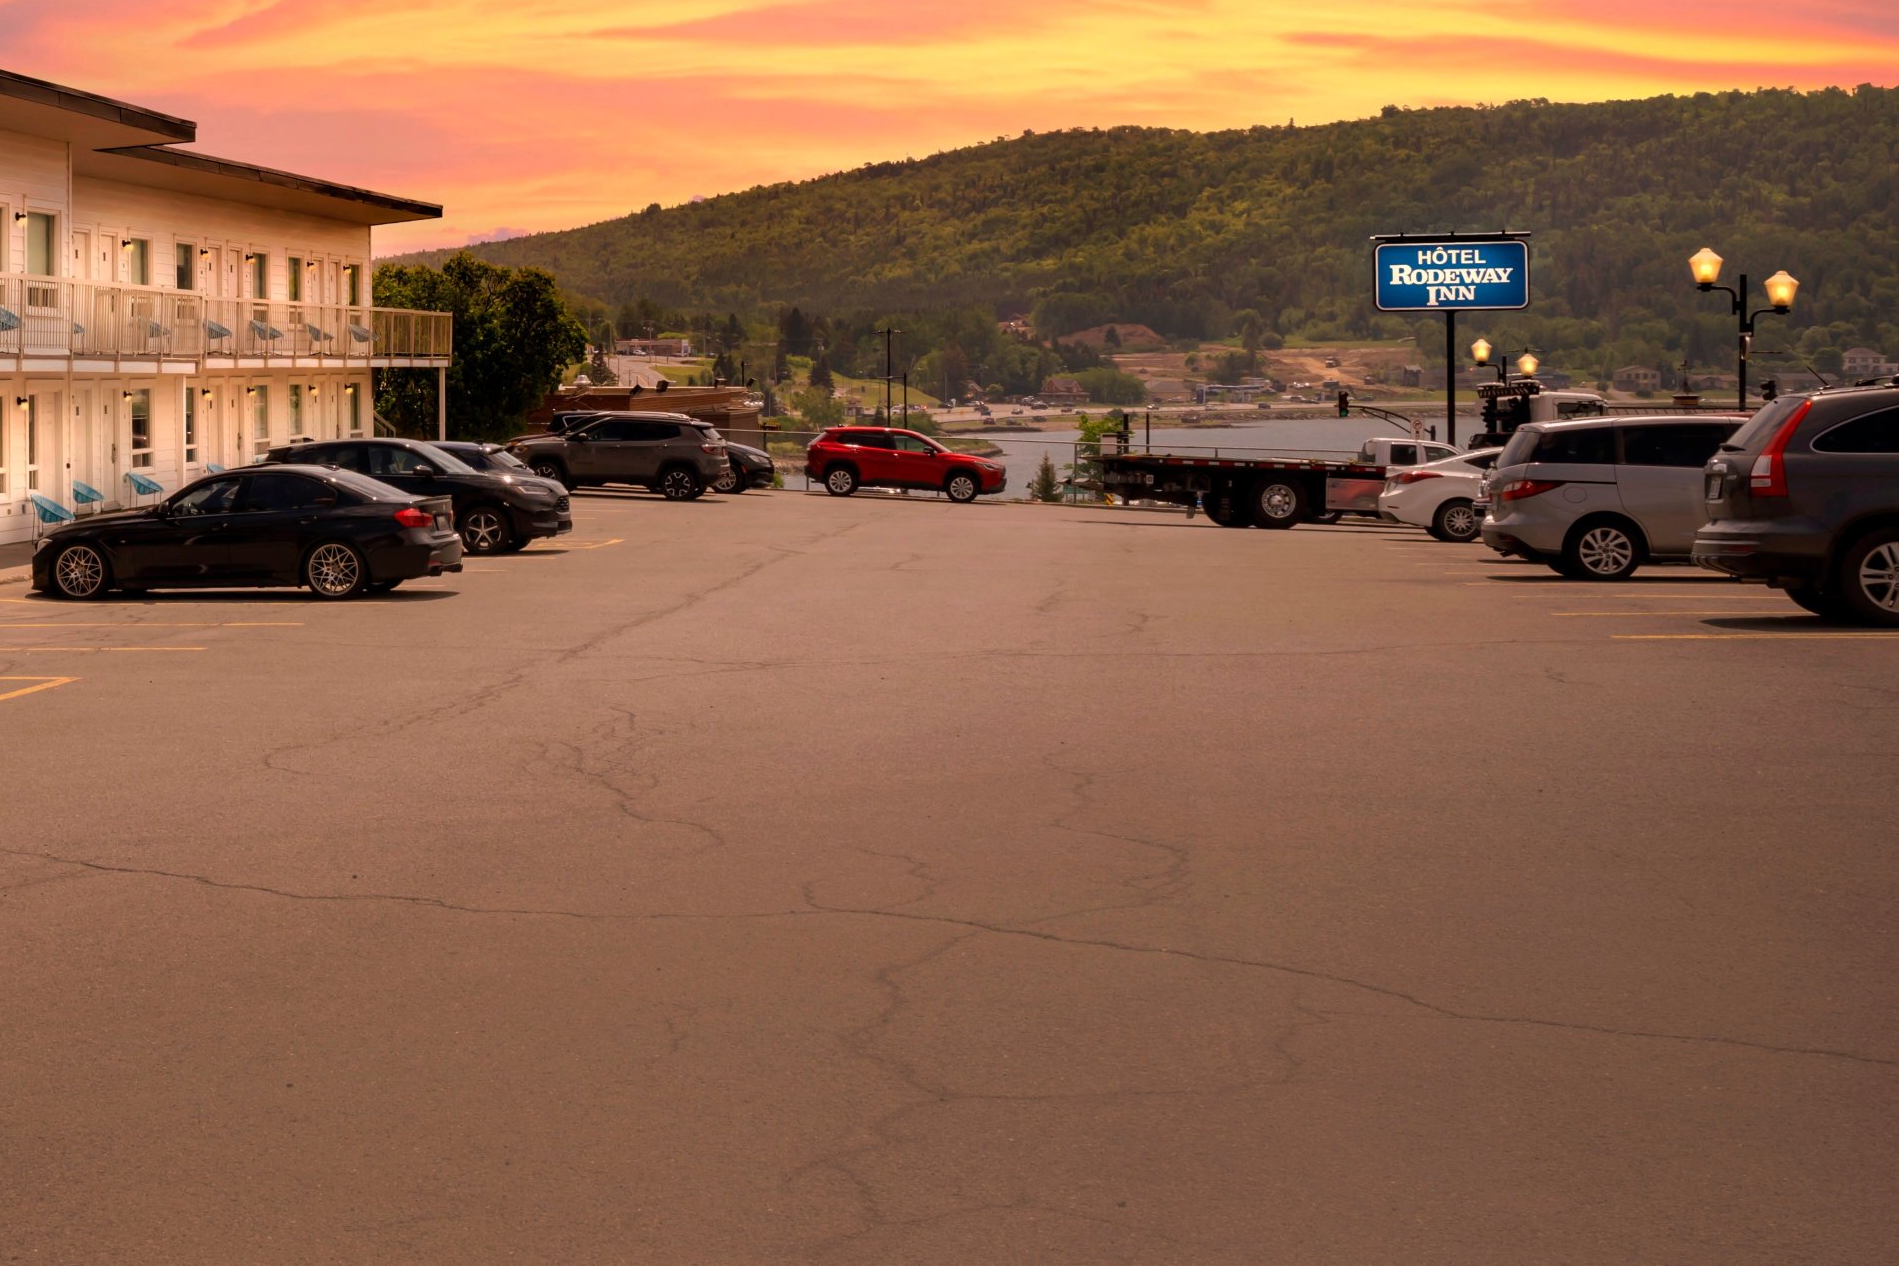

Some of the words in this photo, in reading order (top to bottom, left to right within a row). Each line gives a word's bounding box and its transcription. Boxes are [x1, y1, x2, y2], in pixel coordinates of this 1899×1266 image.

[1418, 247, 1487, 265] HÔTEL
[1389, 264, 1514, 285] RODEWAY
[1426, 285, 1477, 306] INN
